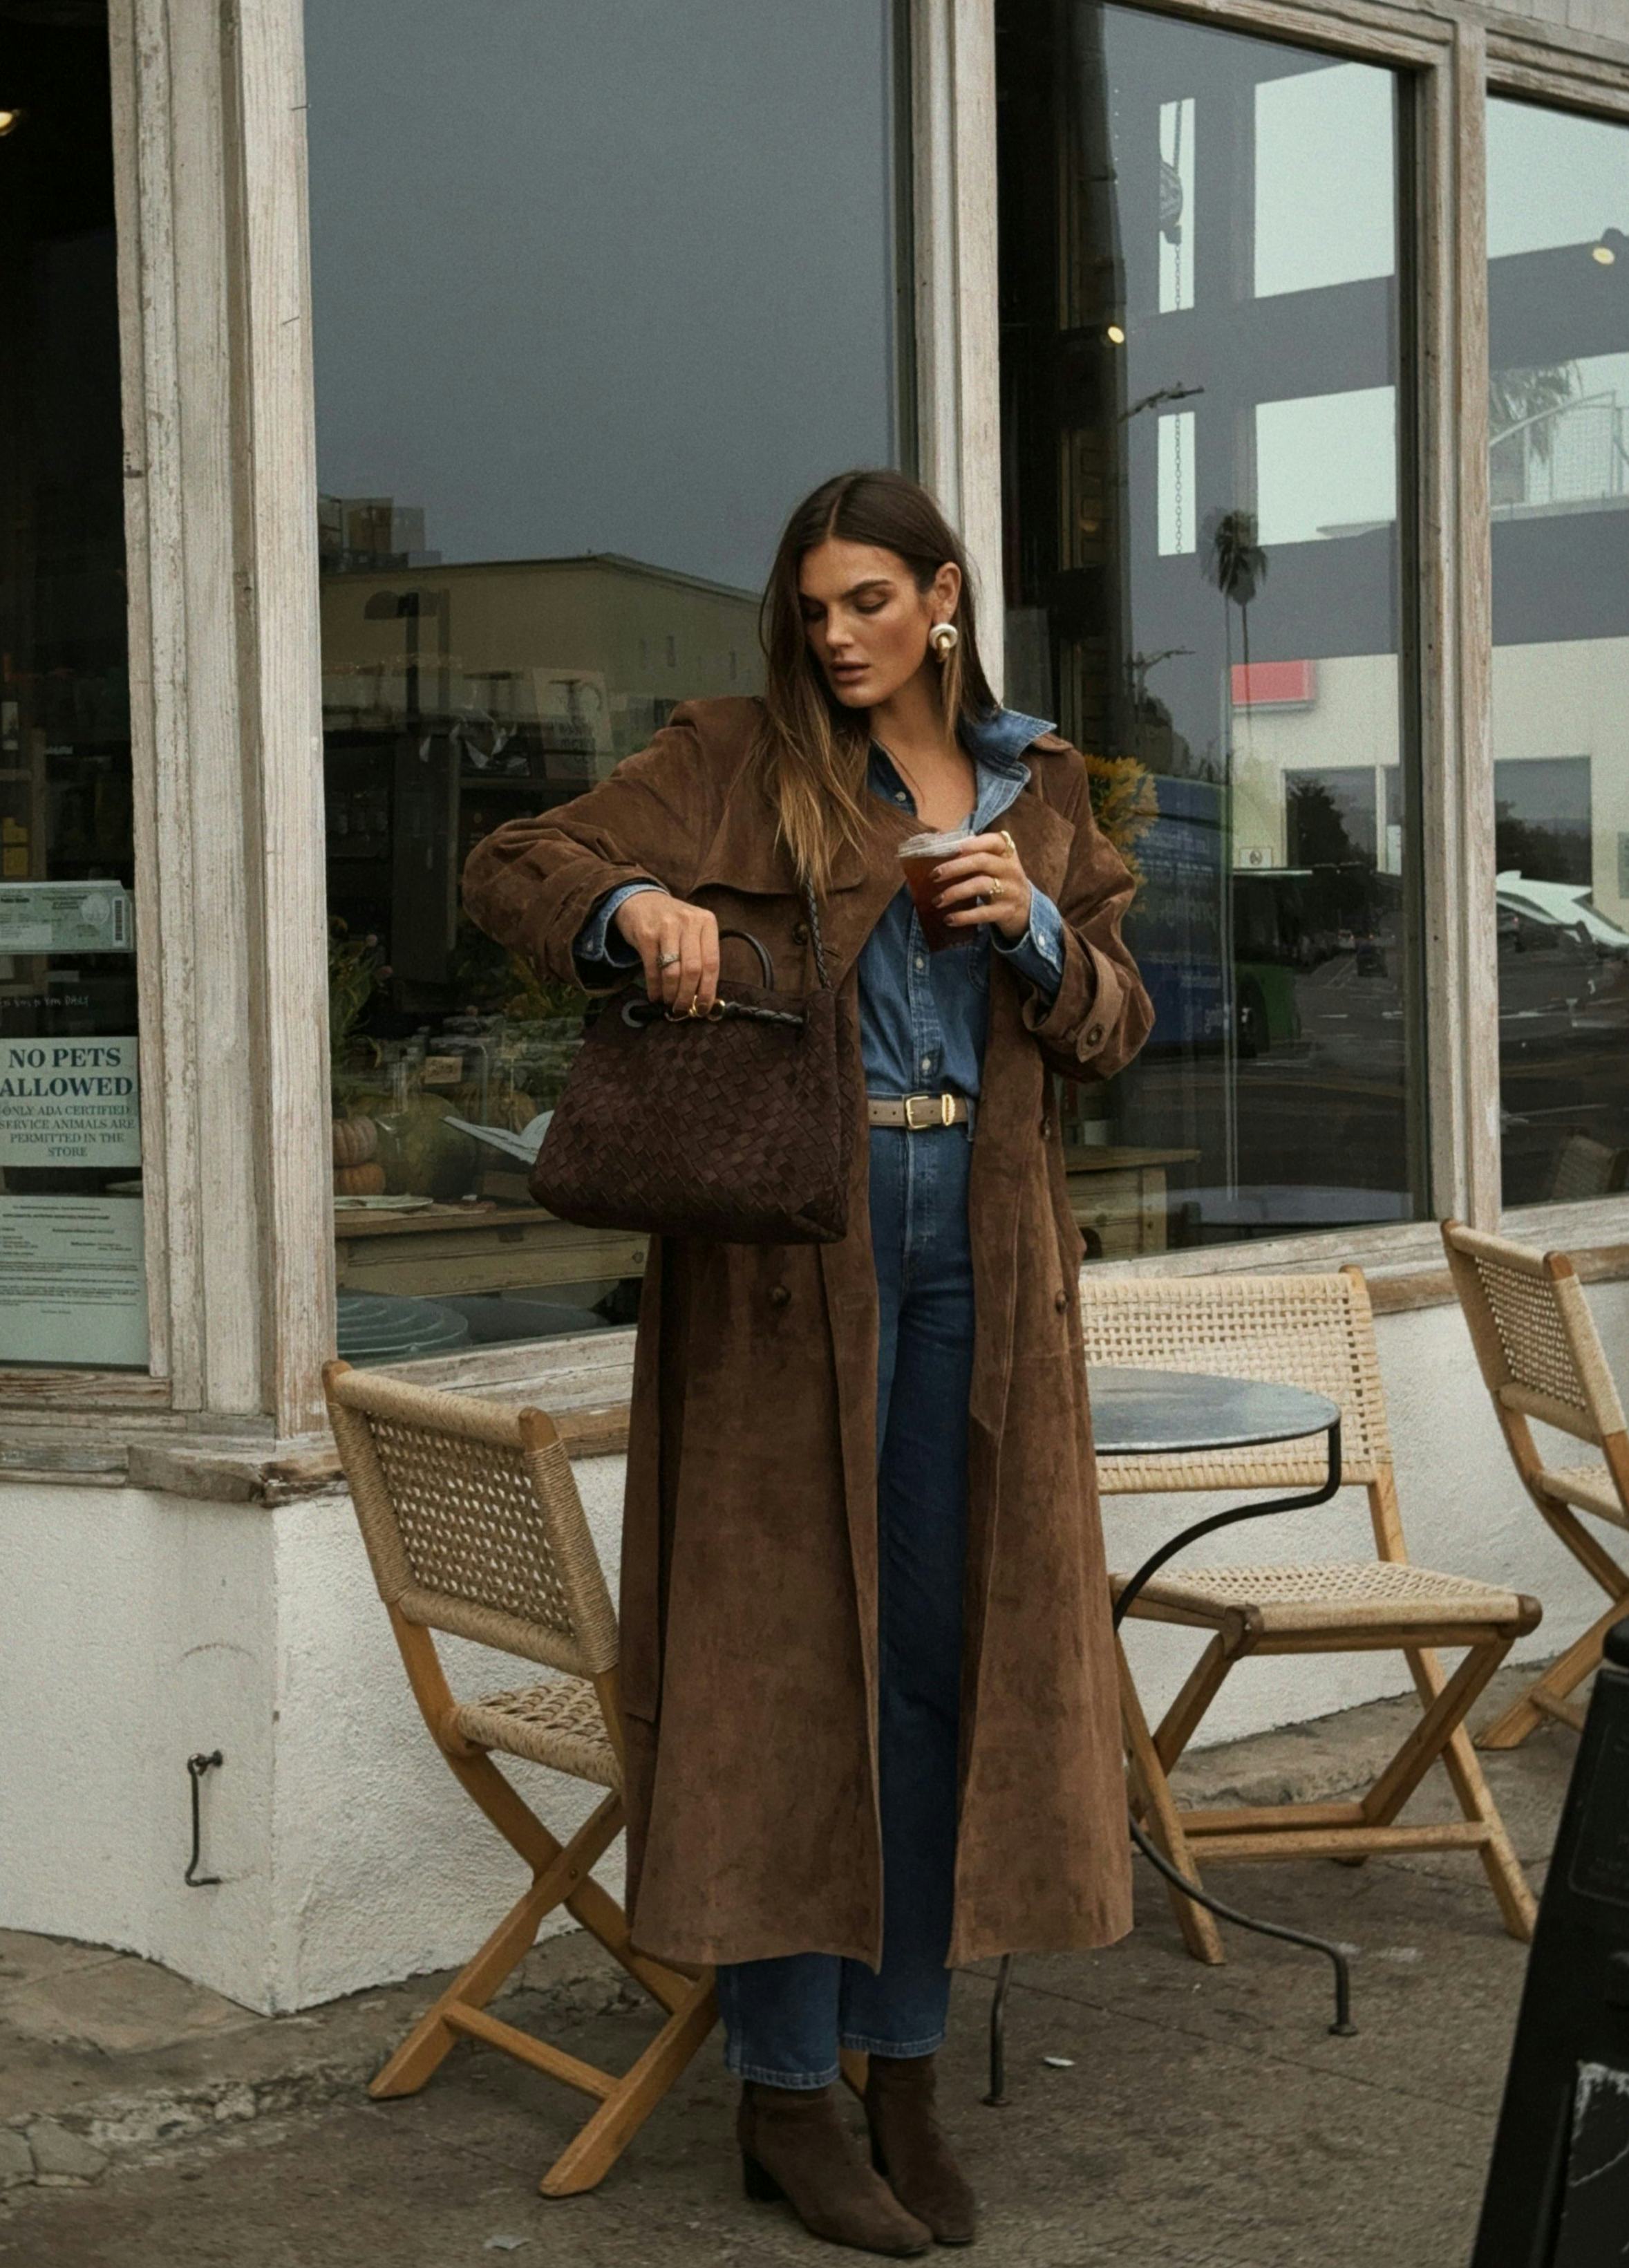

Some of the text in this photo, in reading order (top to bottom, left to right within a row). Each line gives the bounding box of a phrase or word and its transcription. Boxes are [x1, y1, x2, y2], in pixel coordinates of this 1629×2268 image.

[8, 1047, 121, 1068] NO PETS
[0, 1077, 133, 1097] ALLOWED
[2, 1105, 130, 1116] ONLY ADA CERTIFIED
[0, 1119, 135, 1129] SERVICE ANIMALS ARE
[10, 1132, 124, 1143] PERMITTED IN THE
[48, 1147, 88, 1157] STORE
